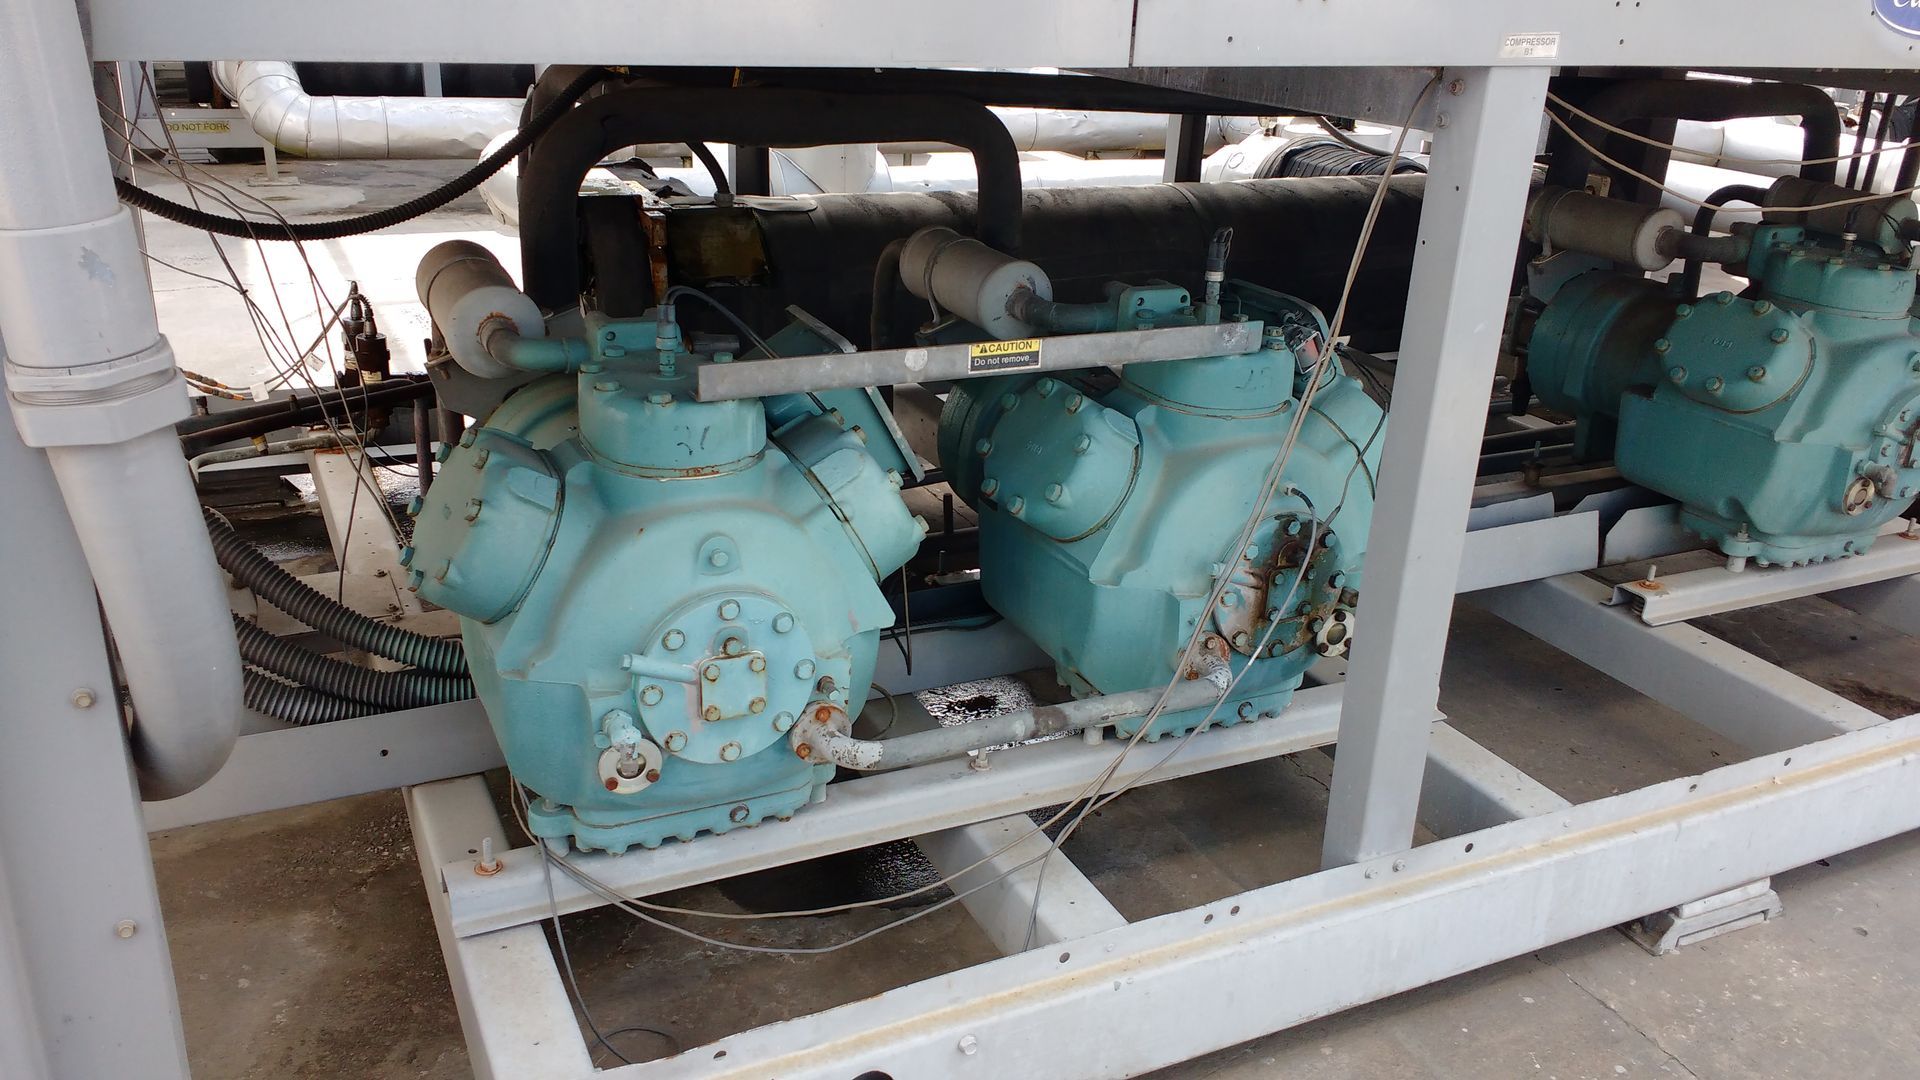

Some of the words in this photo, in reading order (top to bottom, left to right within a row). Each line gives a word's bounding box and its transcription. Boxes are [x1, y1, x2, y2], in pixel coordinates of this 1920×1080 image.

[1505, 37, 1556, 46] COMPRESSOR
[182, 123, 200, 131] NOT
[203, 123, 230, 131] FORK
[988, 341, 1033, 353] CAUTION
[974, 358, 986, 366] Do
[987, 357, 1000, 365] not
